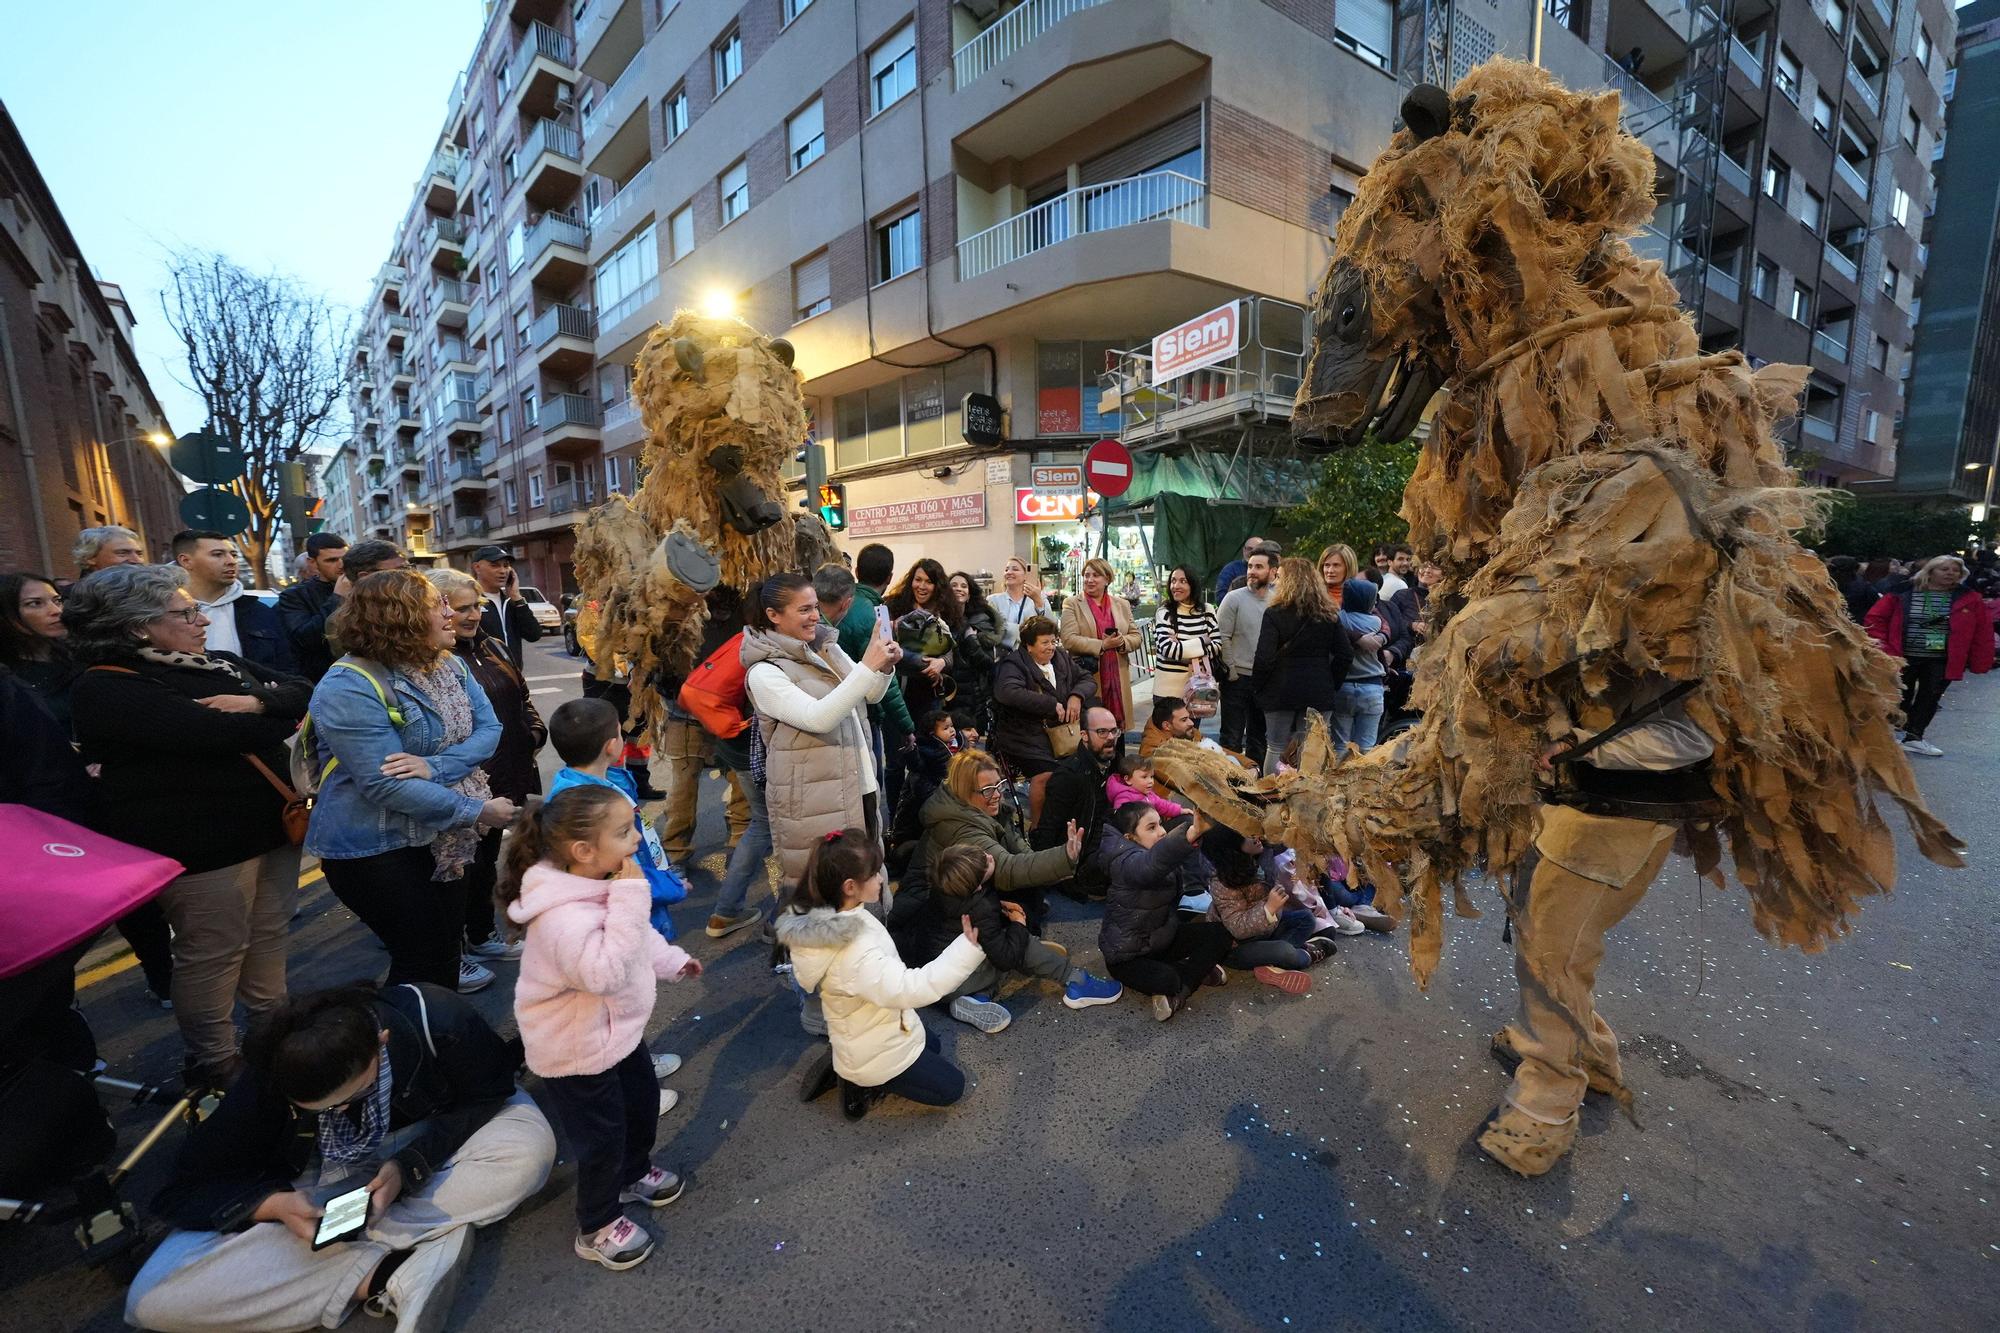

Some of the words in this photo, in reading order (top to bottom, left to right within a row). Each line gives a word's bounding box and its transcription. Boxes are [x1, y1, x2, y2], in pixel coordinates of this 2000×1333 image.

[1160, 316, 1229, 362] Siem
[1036, 470, 1078, 482] Siem
[855, 506, 887, 521] CENTRO
[889, 502, 918, 517] BAZAR
[940, 499, 949, 511] Y
[951, 496, 974, 510] MAS
[950, 507, 983, 517] FERRETERIA
[960, 516, 980, 526] HOGAR
